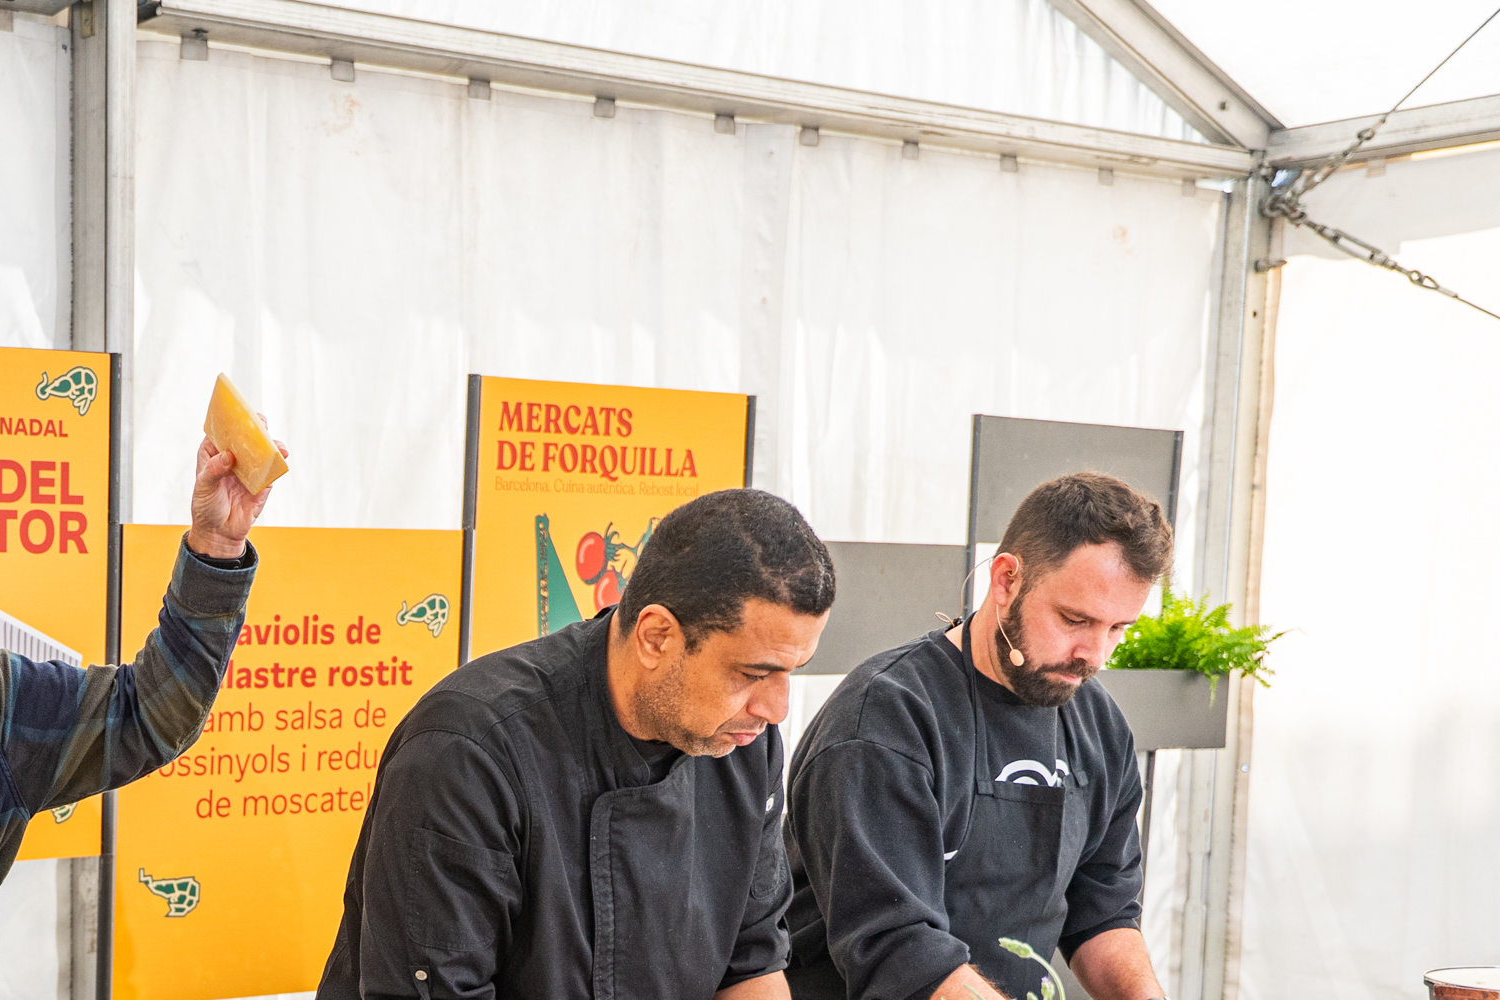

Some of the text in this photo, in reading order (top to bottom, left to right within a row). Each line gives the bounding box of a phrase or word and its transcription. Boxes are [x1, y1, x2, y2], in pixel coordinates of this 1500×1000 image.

[0, 417, 69, 438] NADAL
[497, 400, 634, 438] MERCATS
[495, 440, 698, 482] DE FORQUILLA
[494, 477, 551, 493] Barcelona.
[553, 478, 585, 494] Cuina
[586, 480, 636, 496] autèntica.
[639, 481, 674, 497] Rebost
[237, 613, 382, 646] aviolis de
[221, 656, 414, 689] lastre rostit
[202, 700, 387, 733] amb salsa de
[155, 742, 384, 784] ossinyols i redu
[195, 789, 232, 819] de
